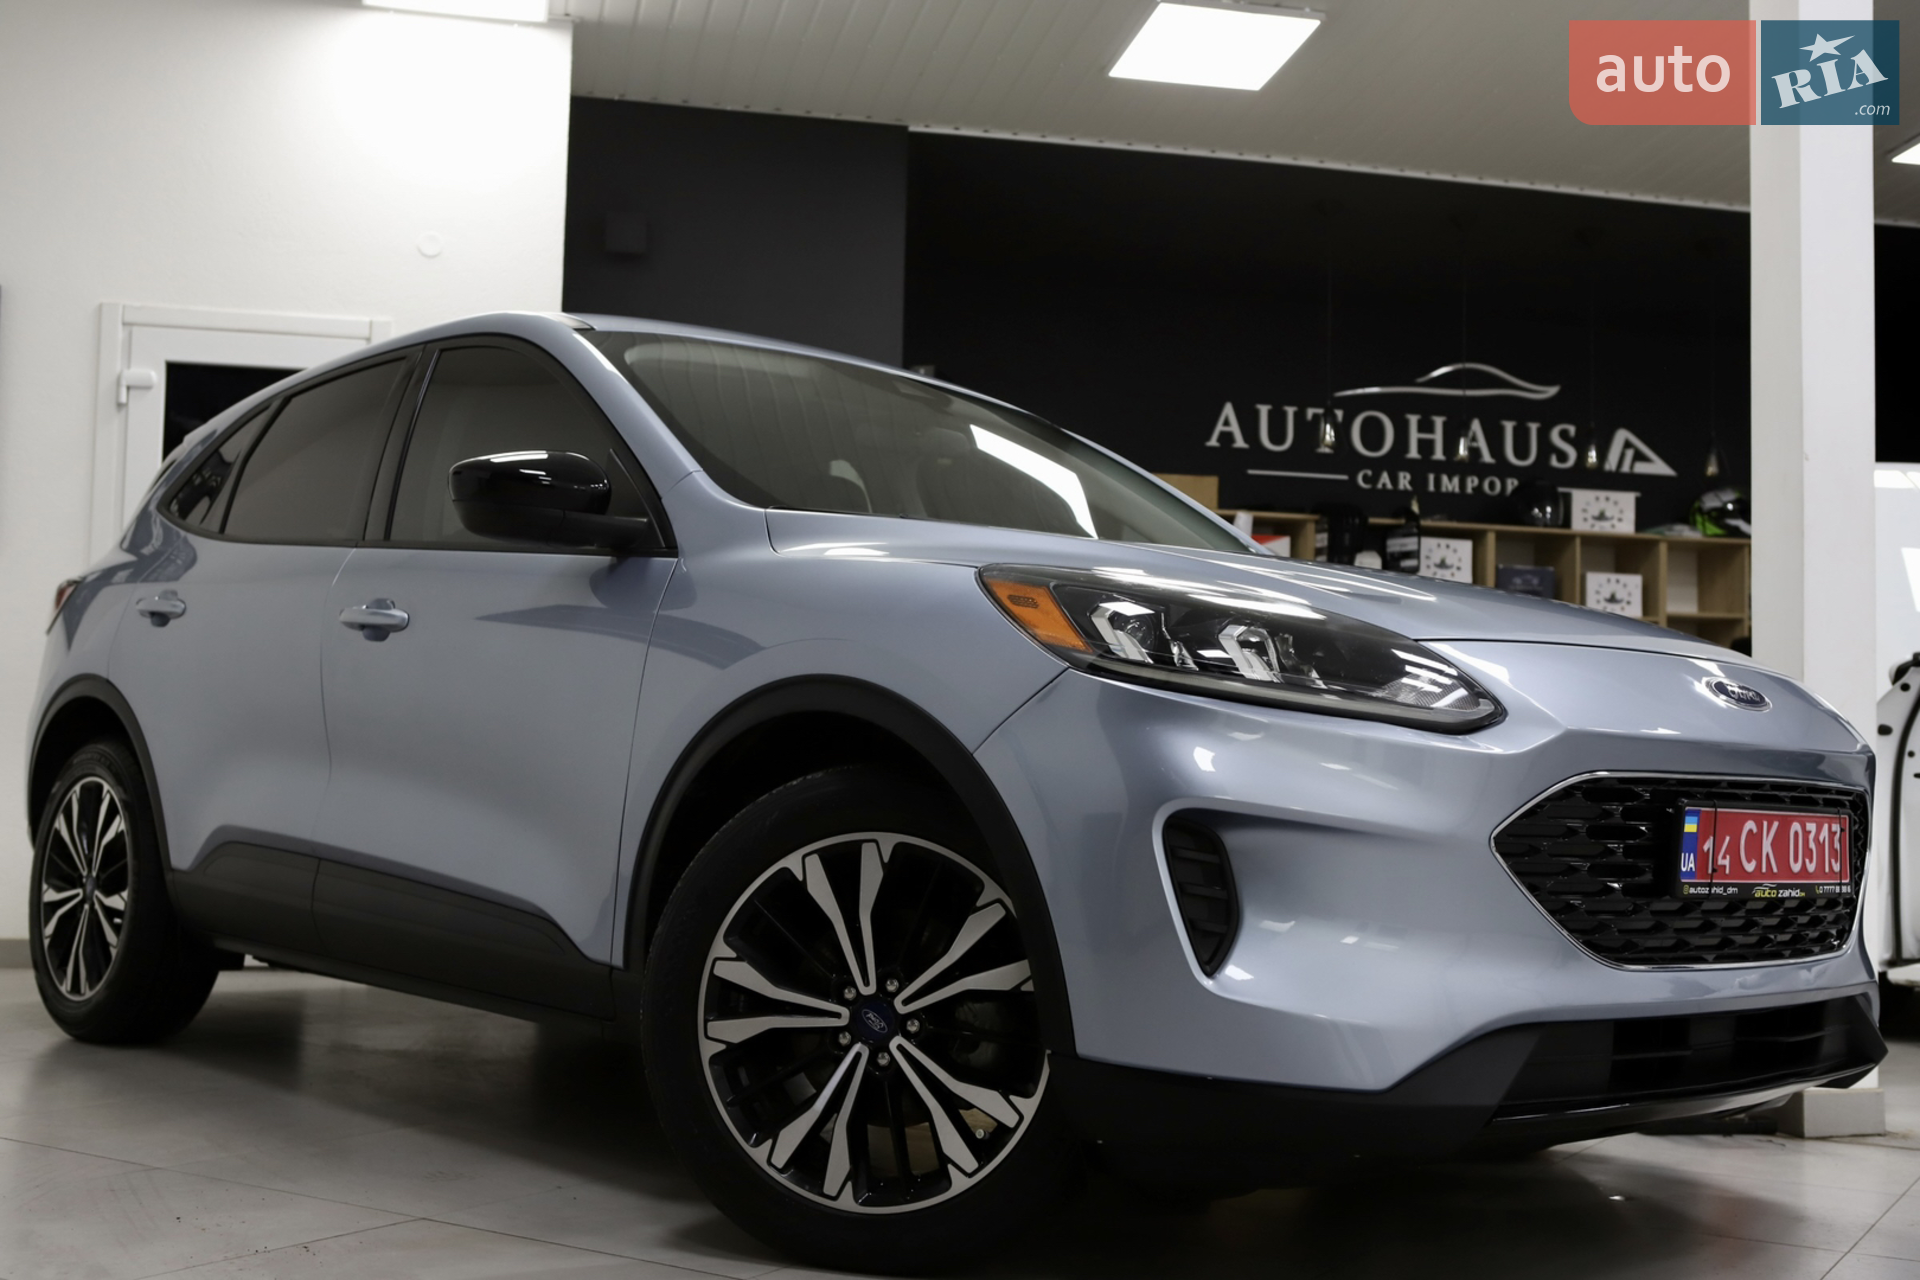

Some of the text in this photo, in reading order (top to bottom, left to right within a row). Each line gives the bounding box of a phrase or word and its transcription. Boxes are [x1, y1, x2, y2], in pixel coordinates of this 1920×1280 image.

[1206, 401, 1578, 469] AUTOHAUS
[1356, 469, 1413, 491] CAR
[1681, 852, 1696, 872] UA
[1702, 820, 1841, 875] 14 CK 0313
